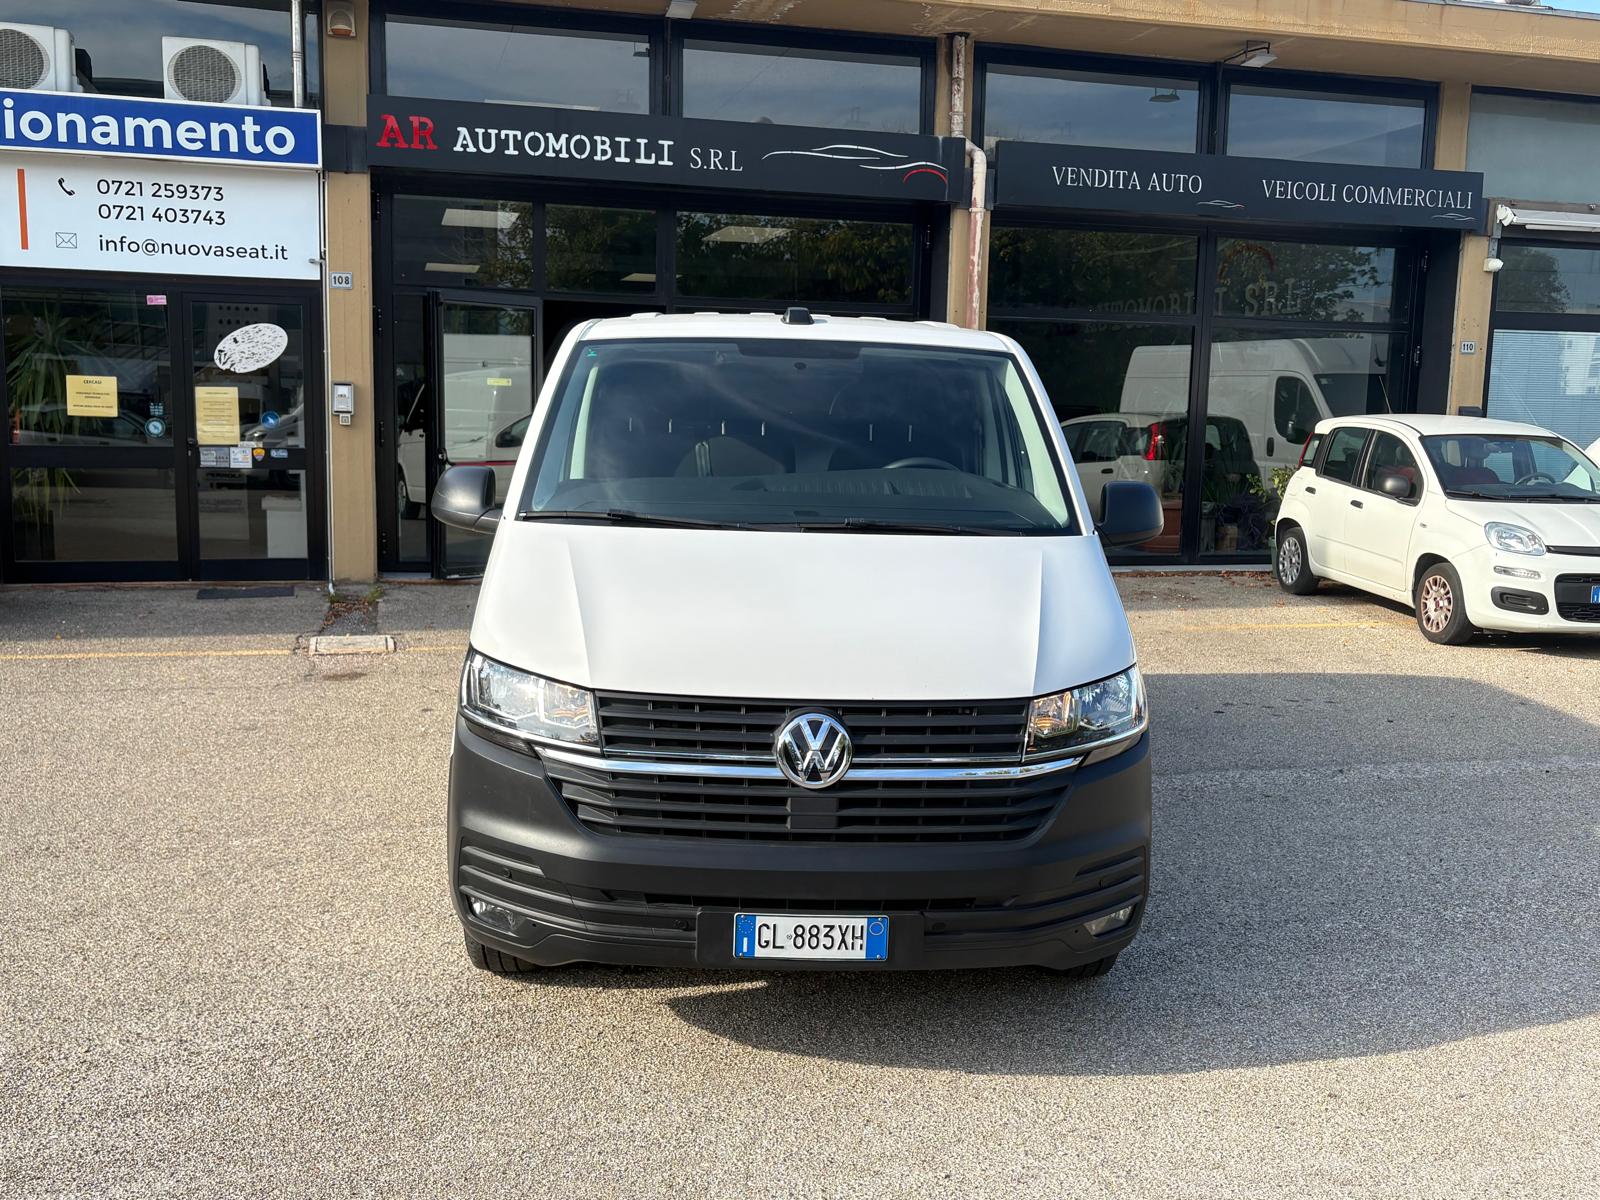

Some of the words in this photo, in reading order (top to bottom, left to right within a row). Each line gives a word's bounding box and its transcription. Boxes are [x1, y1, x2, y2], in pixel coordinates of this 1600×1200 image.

[4, 98, 296, 155] ionamento
[376, 114, 438, 150] AR
[453, 127, 674, 166] AUTOMOBILI
[97, 179, 143, 197] 0721
[151, 183, 224, 202] 259373
[1052, 166, 1141, 191] VENDITA
[1148, 172, 1203, 194] AUTO
[1262, 179, 1337, 202] VEICOLI
[1343, 185, 1473, 209] COMMERCIALI
[98, 204, 145, 222] 0721
[152, 207, 226, 225] 403743
[99, 235, 289, 261] info@nuovaseat.it
[333, 275, 350, 285] 108
[1462, 343, 1474, 351] 110
